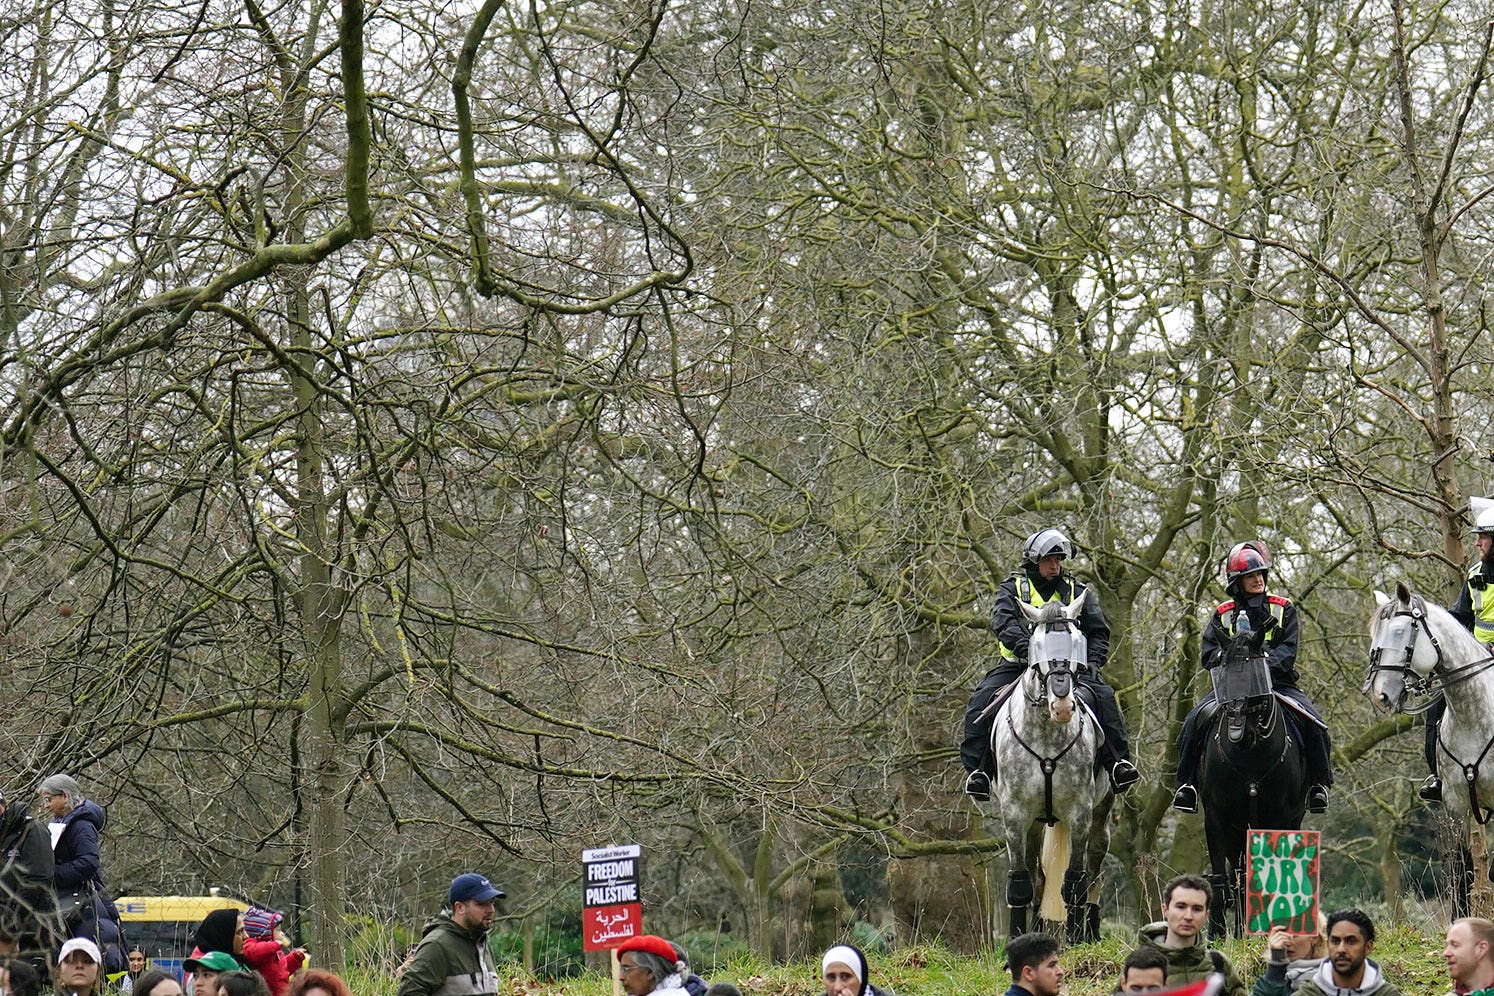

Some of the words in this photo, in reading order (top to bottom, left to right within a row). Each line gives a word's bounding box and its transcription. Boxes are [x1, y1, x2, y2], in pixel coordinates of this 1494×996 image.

[1250, 832, 1318, 859] CEASE
[588, 859, 634, 880] FREEDOM
[586, 884, 637, 905] PALESTINE
[1249, 895, 1316, 933] NOW
